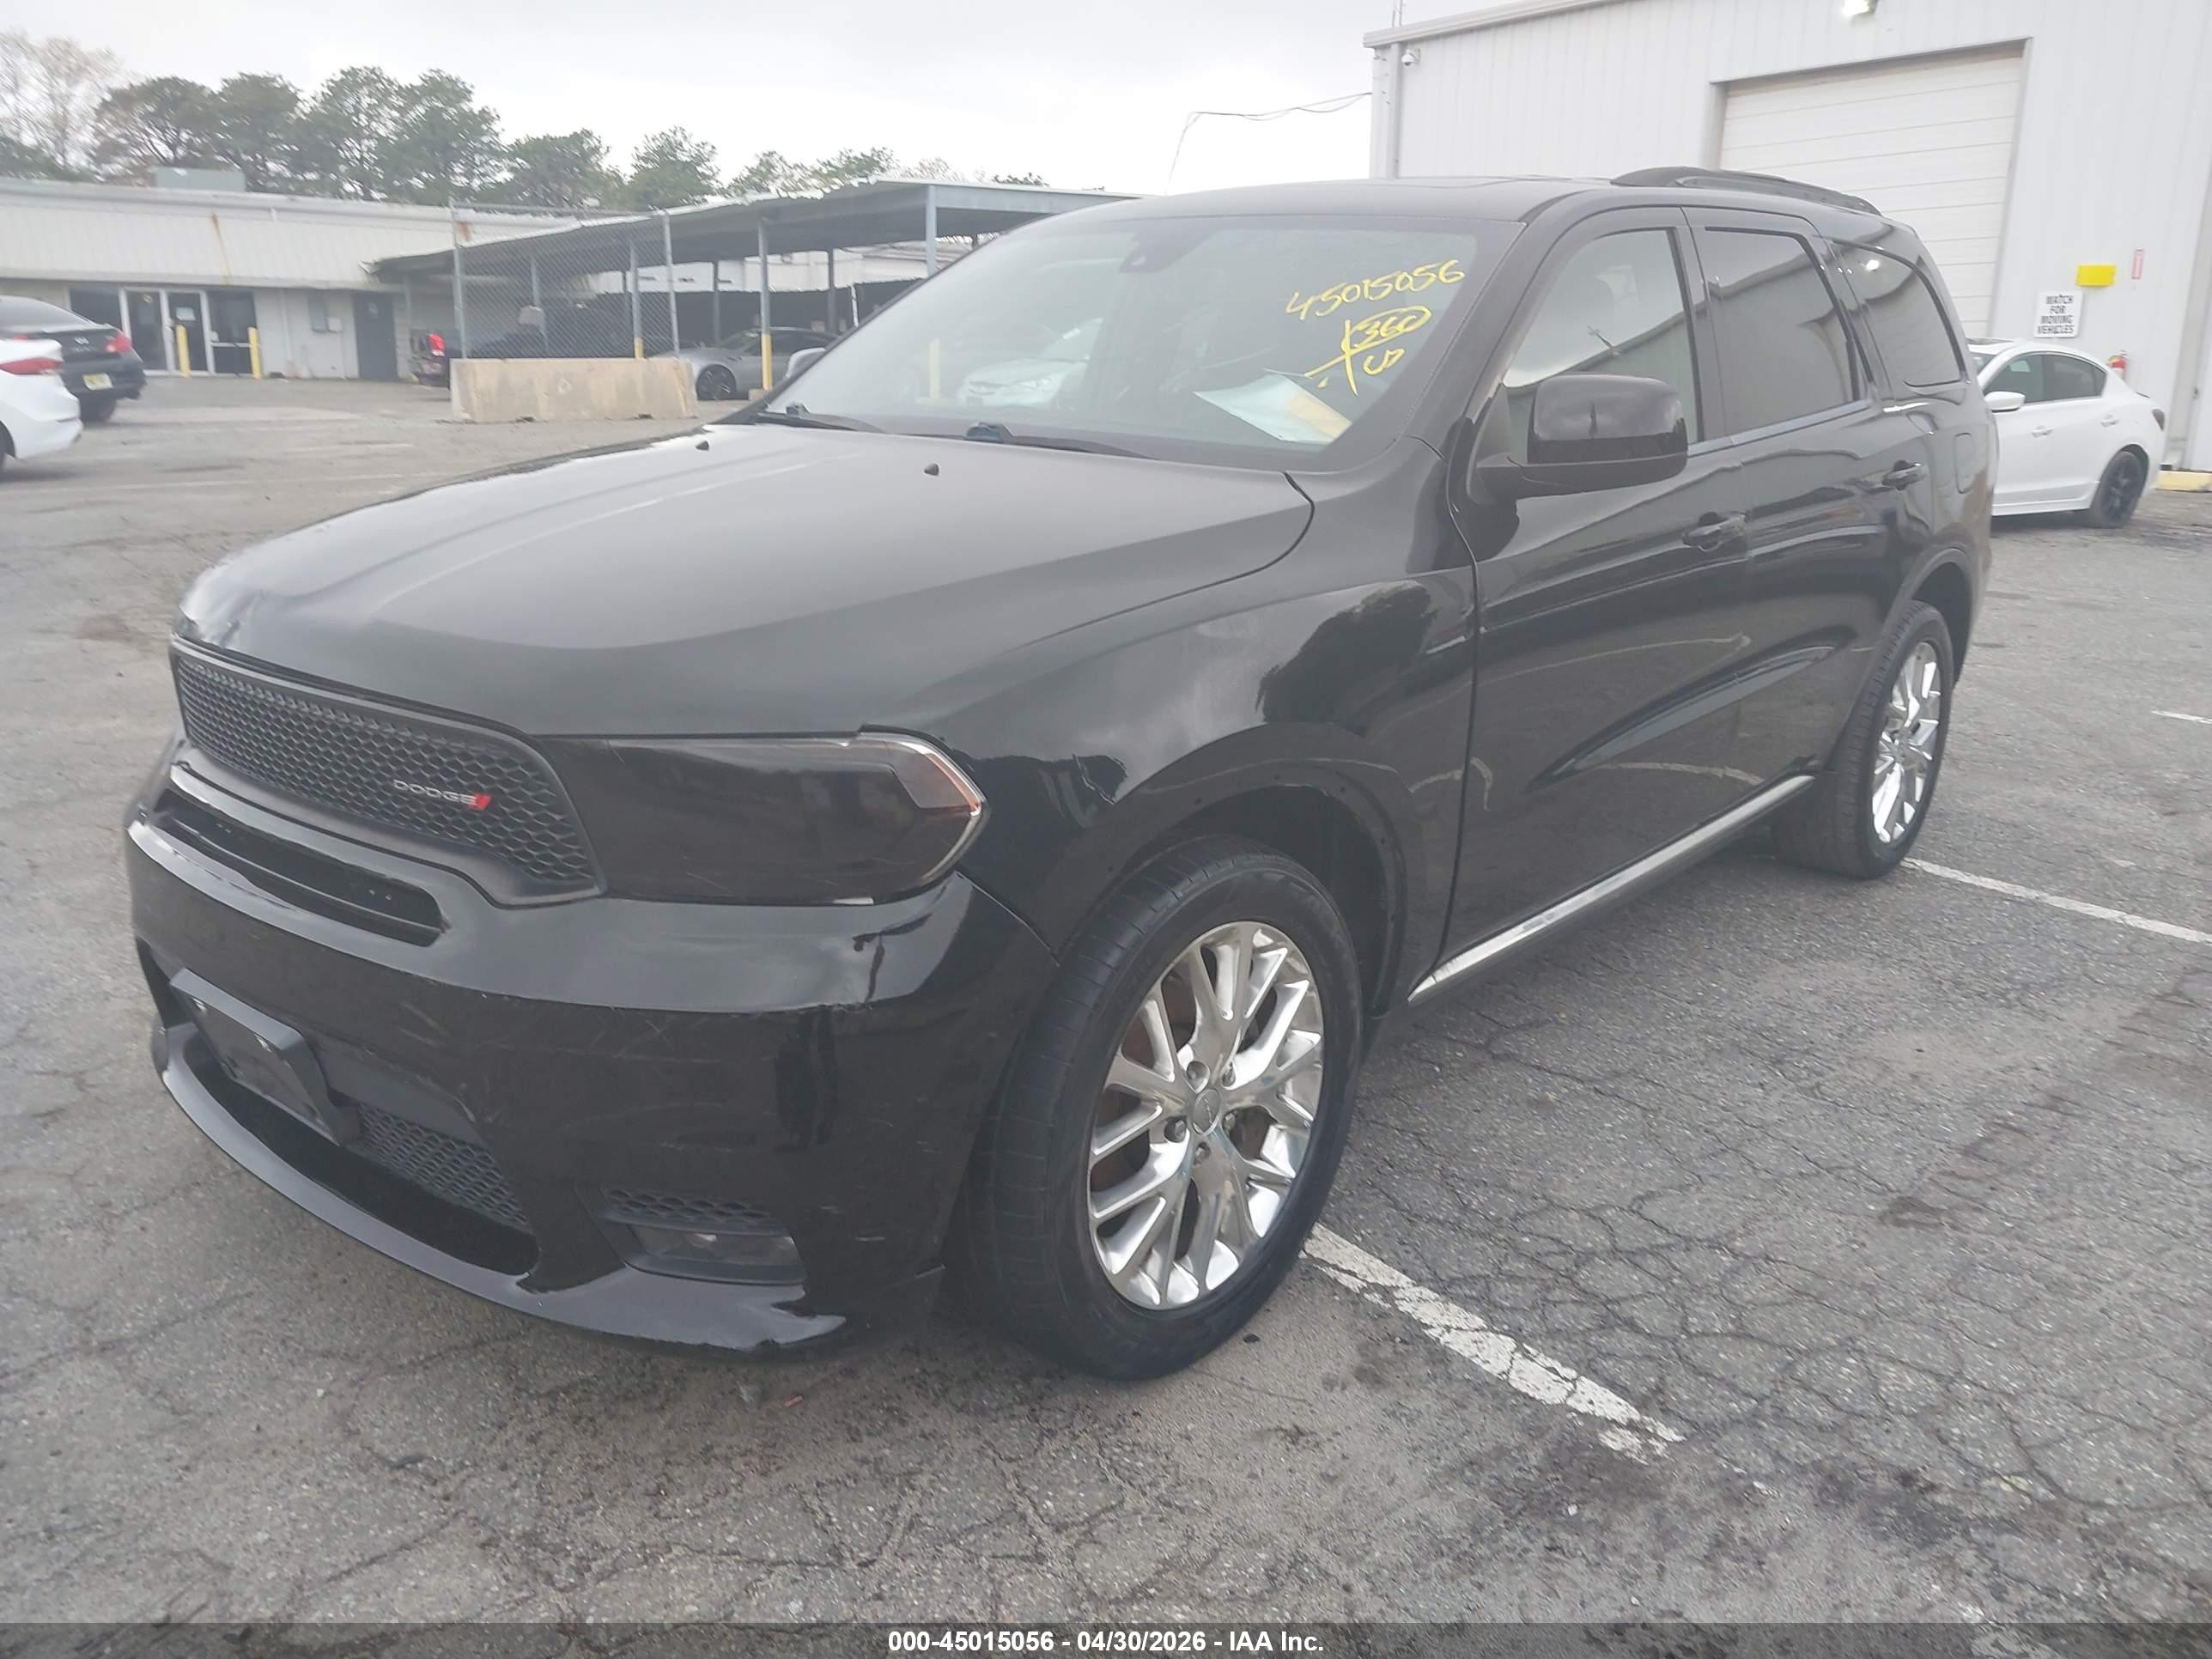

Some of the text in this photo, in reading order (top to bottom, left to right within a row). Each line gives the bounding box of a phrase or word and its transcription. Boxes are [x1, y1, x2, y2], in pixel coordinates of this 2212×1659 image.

[1285, 259, 1465, 320] 45015056
[2045, 295, 2074, 304] WATCH
[2050, 305, 2066, 314] FOR
[2040, 315, 2074, 324] MOVING
[2037, 325, 2075, 334] VEHICLES
[393, 779, 477, 805] DODGE
